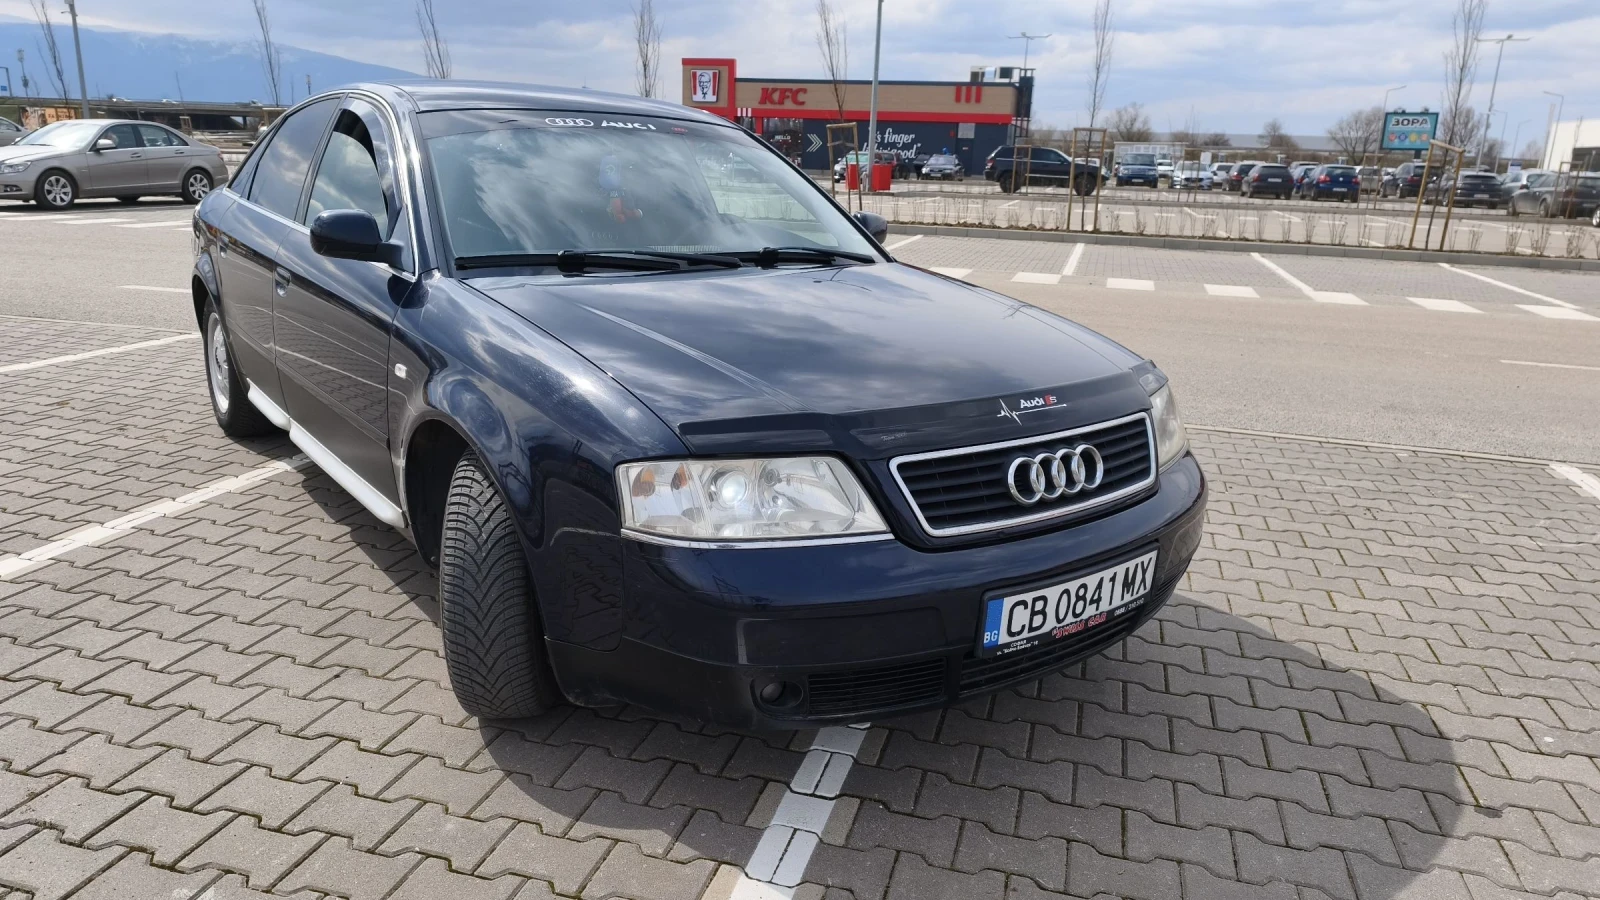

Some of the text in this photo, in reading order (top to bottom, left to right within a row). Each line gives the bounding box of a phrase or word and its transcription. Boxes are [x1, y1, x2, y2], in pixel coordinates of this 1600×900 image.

[758, 87, 808, 105] KFC
[1391, 117, 1430, 127] ЗОРА
[884, 128, 915, 147] finger
[1020, 397, 1045, 408] Audi
[1007, 557, 1153, 638] CB 0841 MX
[984, 631, 998, 645] BG
